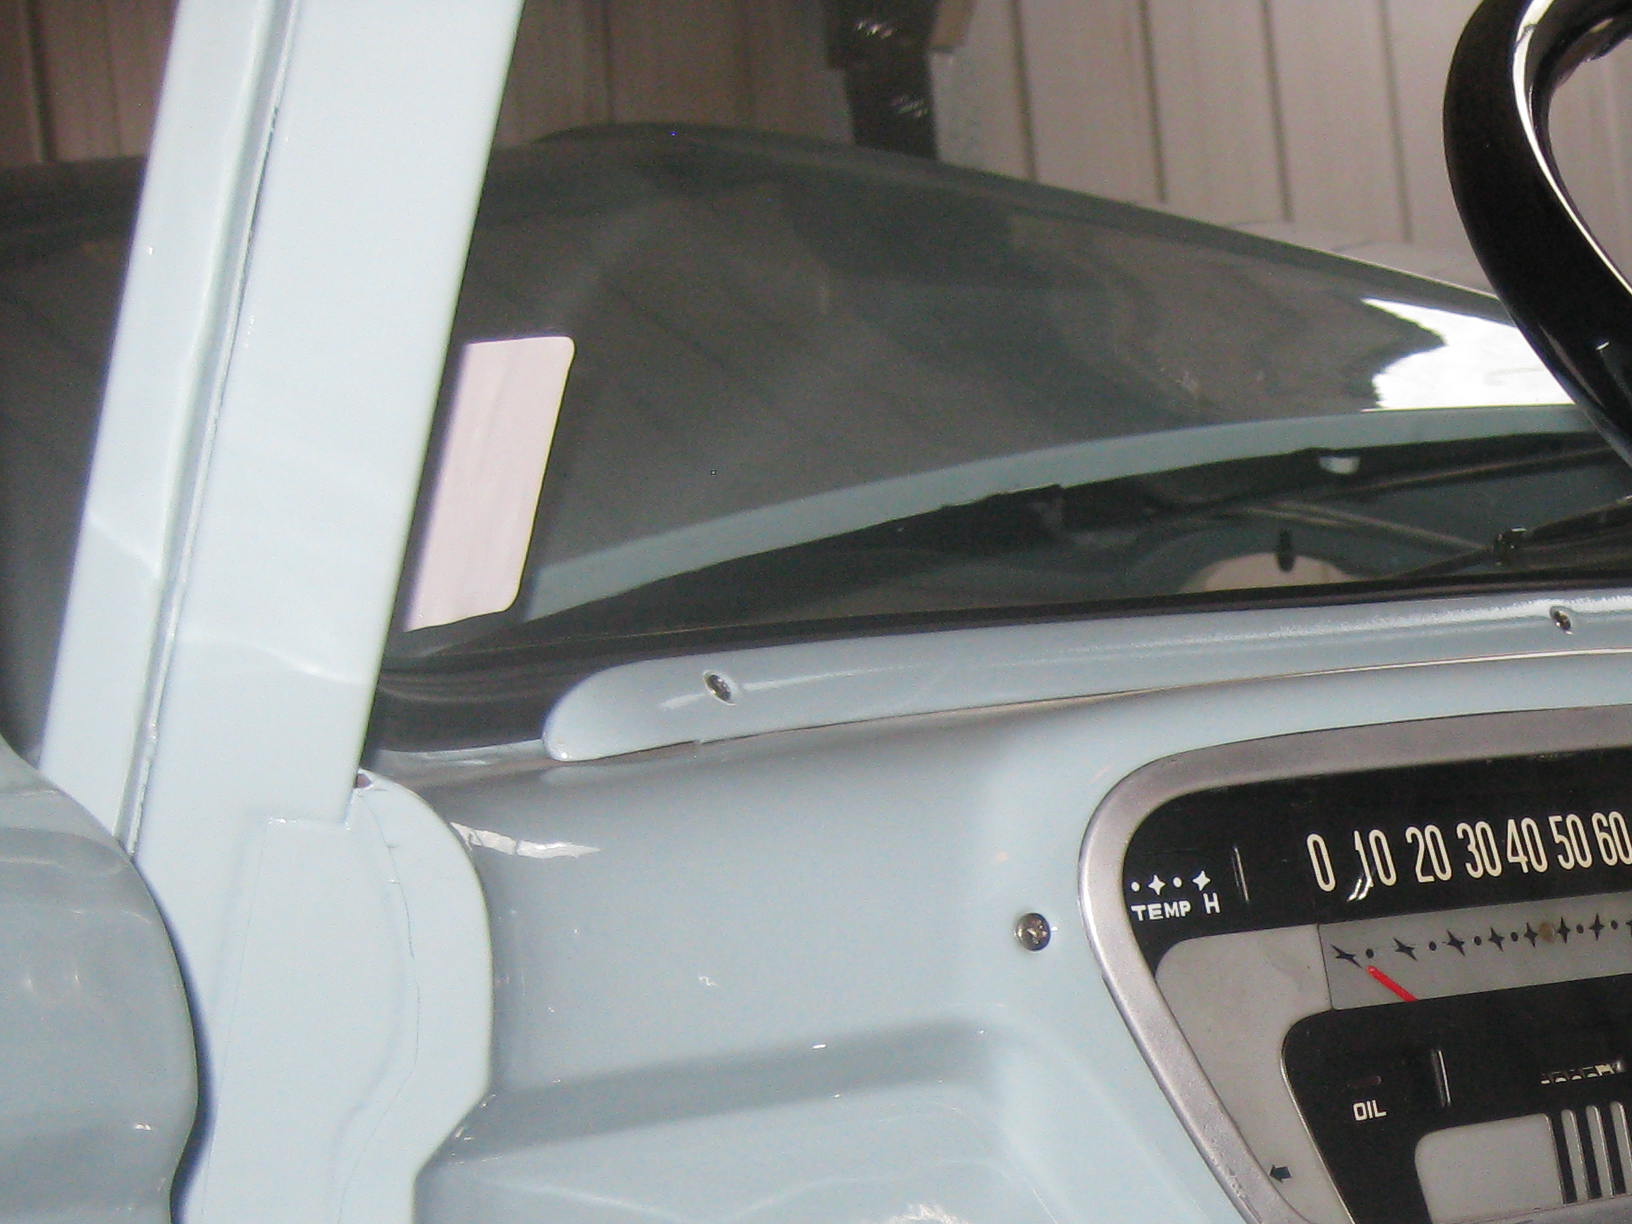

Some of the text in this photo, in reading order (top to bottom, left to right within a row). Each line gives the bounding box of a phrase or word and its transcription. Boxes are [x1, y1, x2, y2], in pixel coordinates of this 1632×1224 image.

[1306, 833, 1337, 892] 0
[1353, 829, 1398, 887] 10
[1404, 824, 1453, 883] 20
[1455, 820, 1503, 879] 30
[1506, 817, 1549, 874] 40
[1548, 813, 1594, 870] 50
[1130, 892, 1221, 922] TEMP H
[1352, 1099, 1388, 1121] OIL
